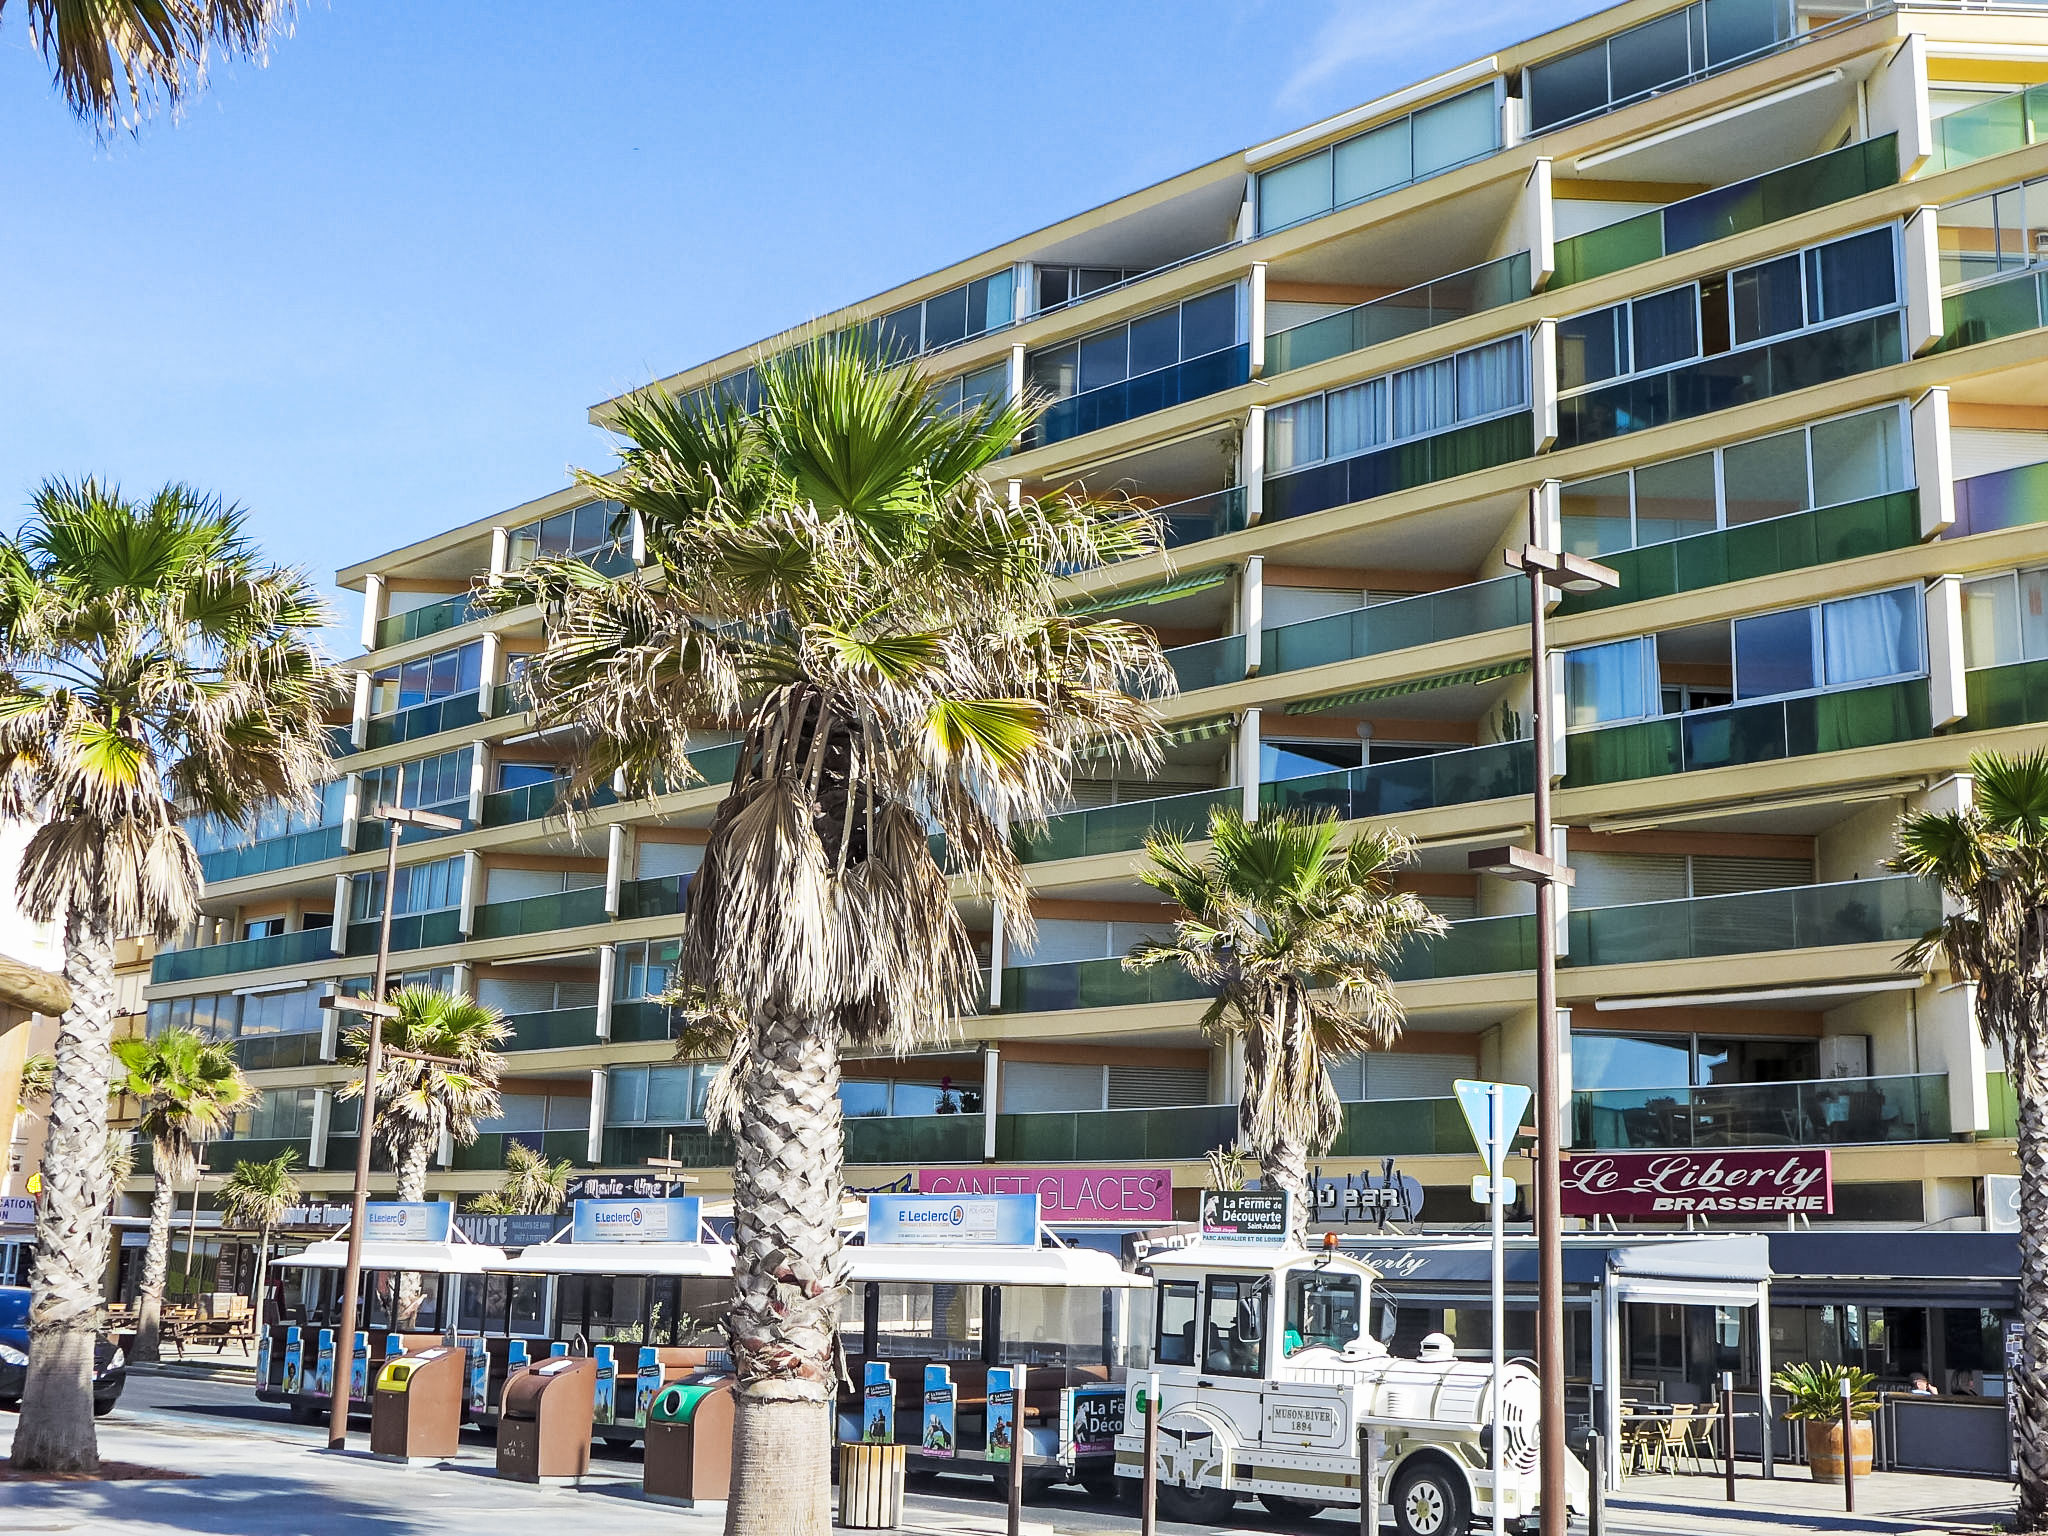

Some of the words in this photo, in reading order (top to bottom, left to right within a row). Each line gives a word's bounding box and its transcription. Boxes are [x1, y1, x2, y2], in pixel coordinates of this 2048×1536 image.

[1561, 1158, 1652, 1195] Le
[1634, 1157, 1823, 1195] Liberty
[1037, 1177, 1156, 1211] GLACES
[1223, 1198, 1236, 1209] La
[1239, 1198, 1271, 1209] Ferme
[1652, 1196, 1824, 1211] BRASSERIE
[1222, 1210, 1282, 1222] Découverte
[1090, 1400, 1105, 1415] La
[1090, 1416, 1123, 1433] Déco
[1292, 1421, 1311, 1431] 1894
